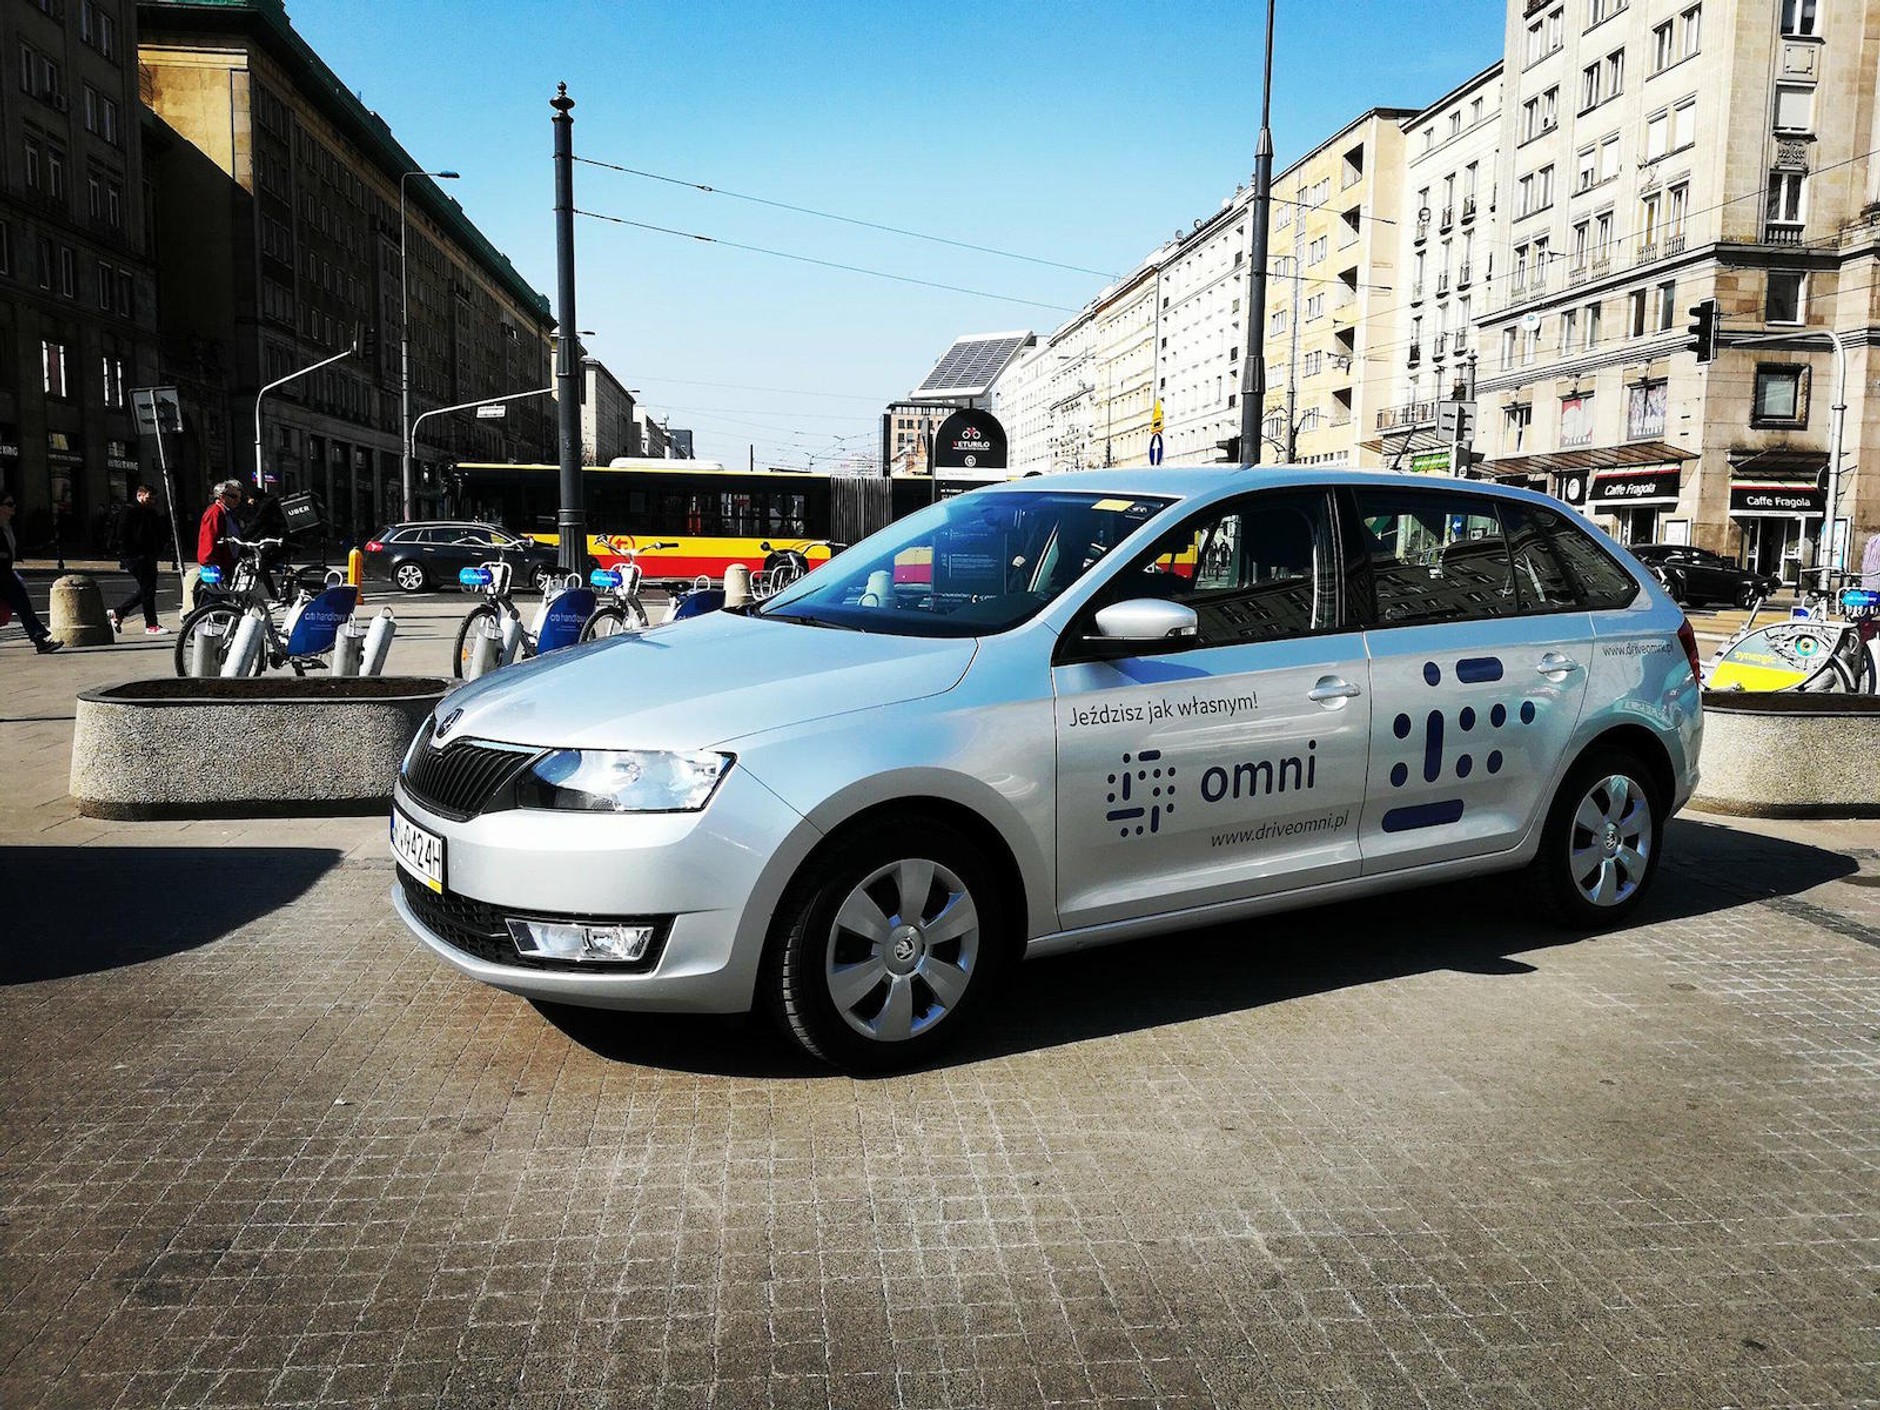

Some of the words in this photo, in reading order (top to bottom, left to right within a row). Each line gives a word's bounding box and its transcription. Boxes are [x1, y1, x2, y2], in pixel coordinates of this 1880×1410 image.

[1604, 484, 1625, 496] Caffe
[1627, 482, 1657, 496] Fragola
[287, 505, 310, 516] UBER
[1746, 496, 1773, 506] Caffe
[1775, 497, 1811, 509] Fragola
[1069, 702, 1144, 727] Jeździsz
[1149, 699, 1173, 724] jak
[1178, 691, 1259, 717] własnym!
[1201, 739, 1316, 803] omni
[1211, 810, 1348, 847] www.driveomni.pl
